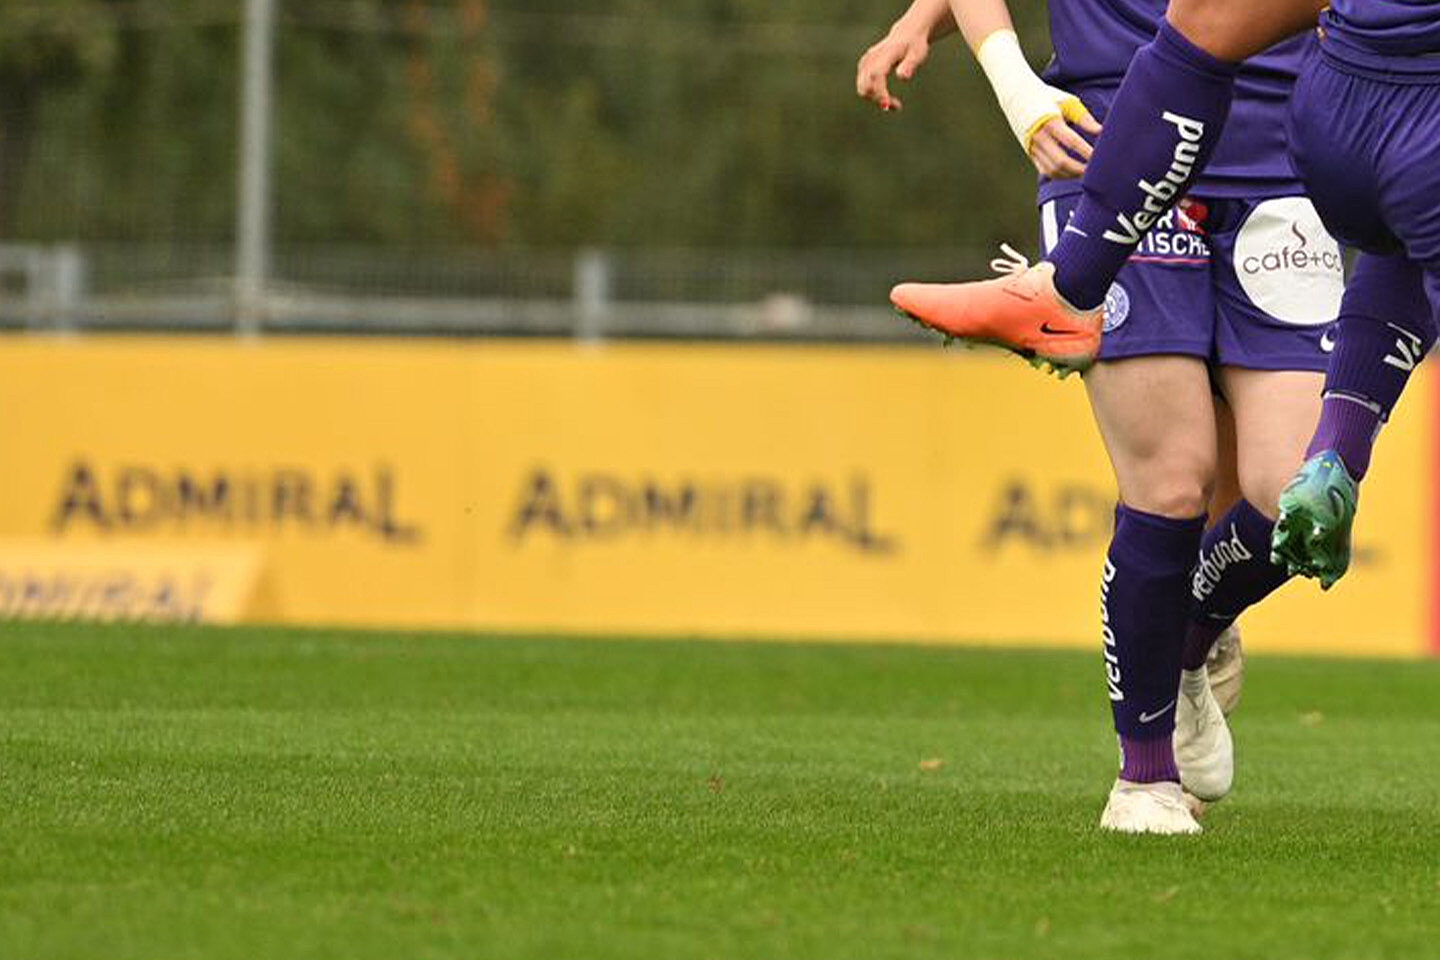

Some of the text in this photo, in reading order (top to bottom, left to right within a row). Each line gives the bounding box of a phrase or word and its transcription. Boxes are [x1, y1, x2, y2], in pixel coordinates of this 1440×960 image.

[1103, 110, 1205, 244] Verbund
[50, 457, 425, 546] ADMIRAL
[508, 465, 900, 555] ADMIRAL
